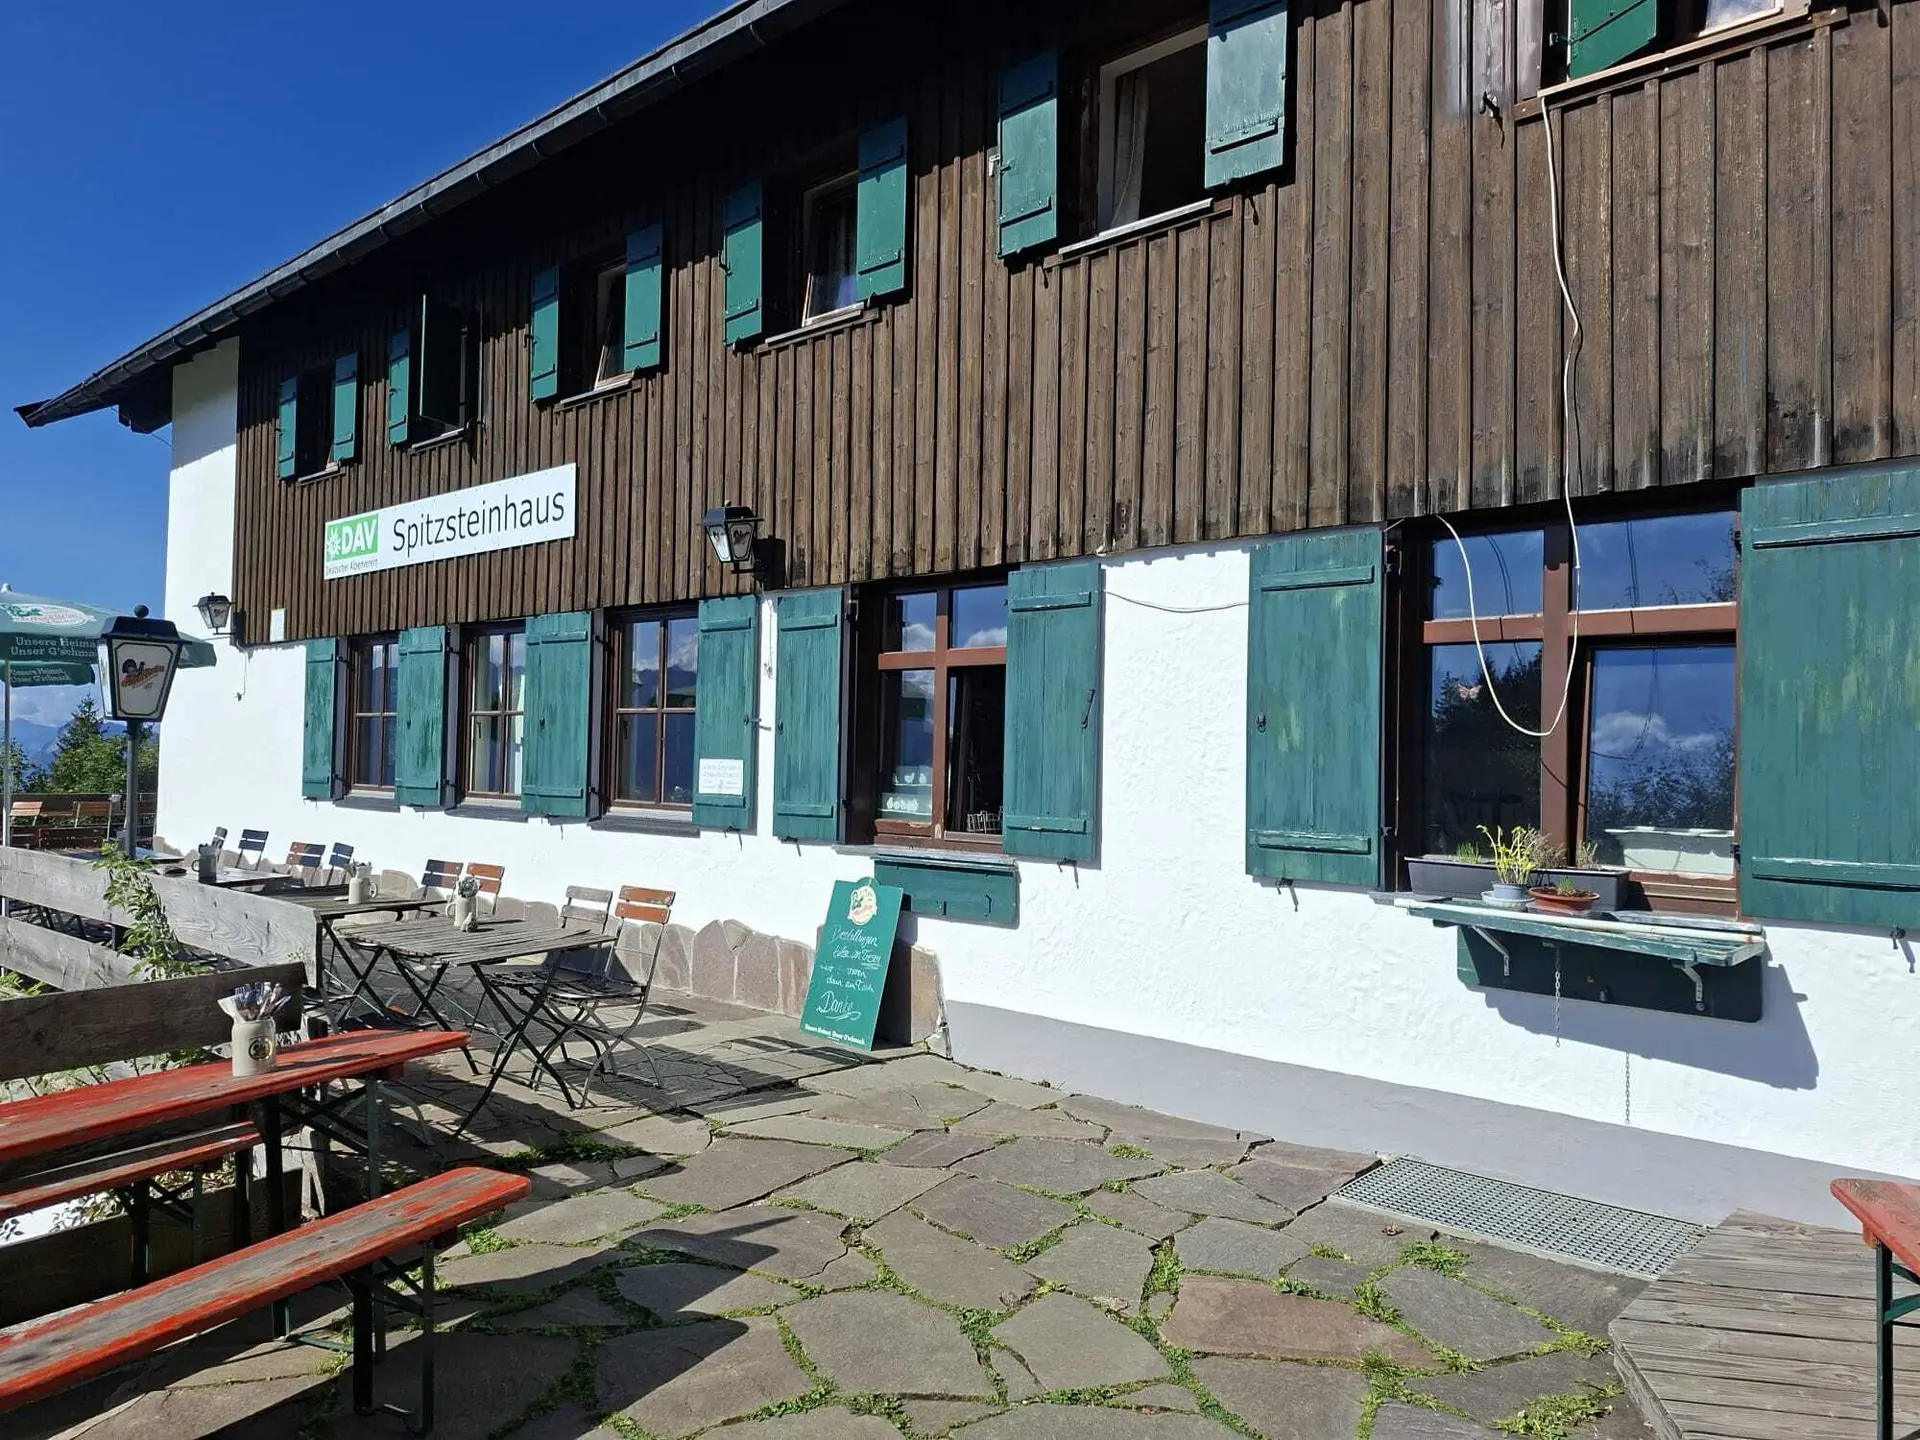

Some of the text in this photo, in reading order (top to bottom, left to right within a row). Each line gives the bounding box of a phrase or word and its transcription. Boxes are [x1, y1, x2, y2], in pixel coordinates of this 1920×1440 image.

[393, 492, 565, 557] Spitzsteinhaus
[342, 519, 378, 555] DAV
[10, 646, 99, 657] Unser G'schma
[15, 636, 98, 648] Unsere Heima
